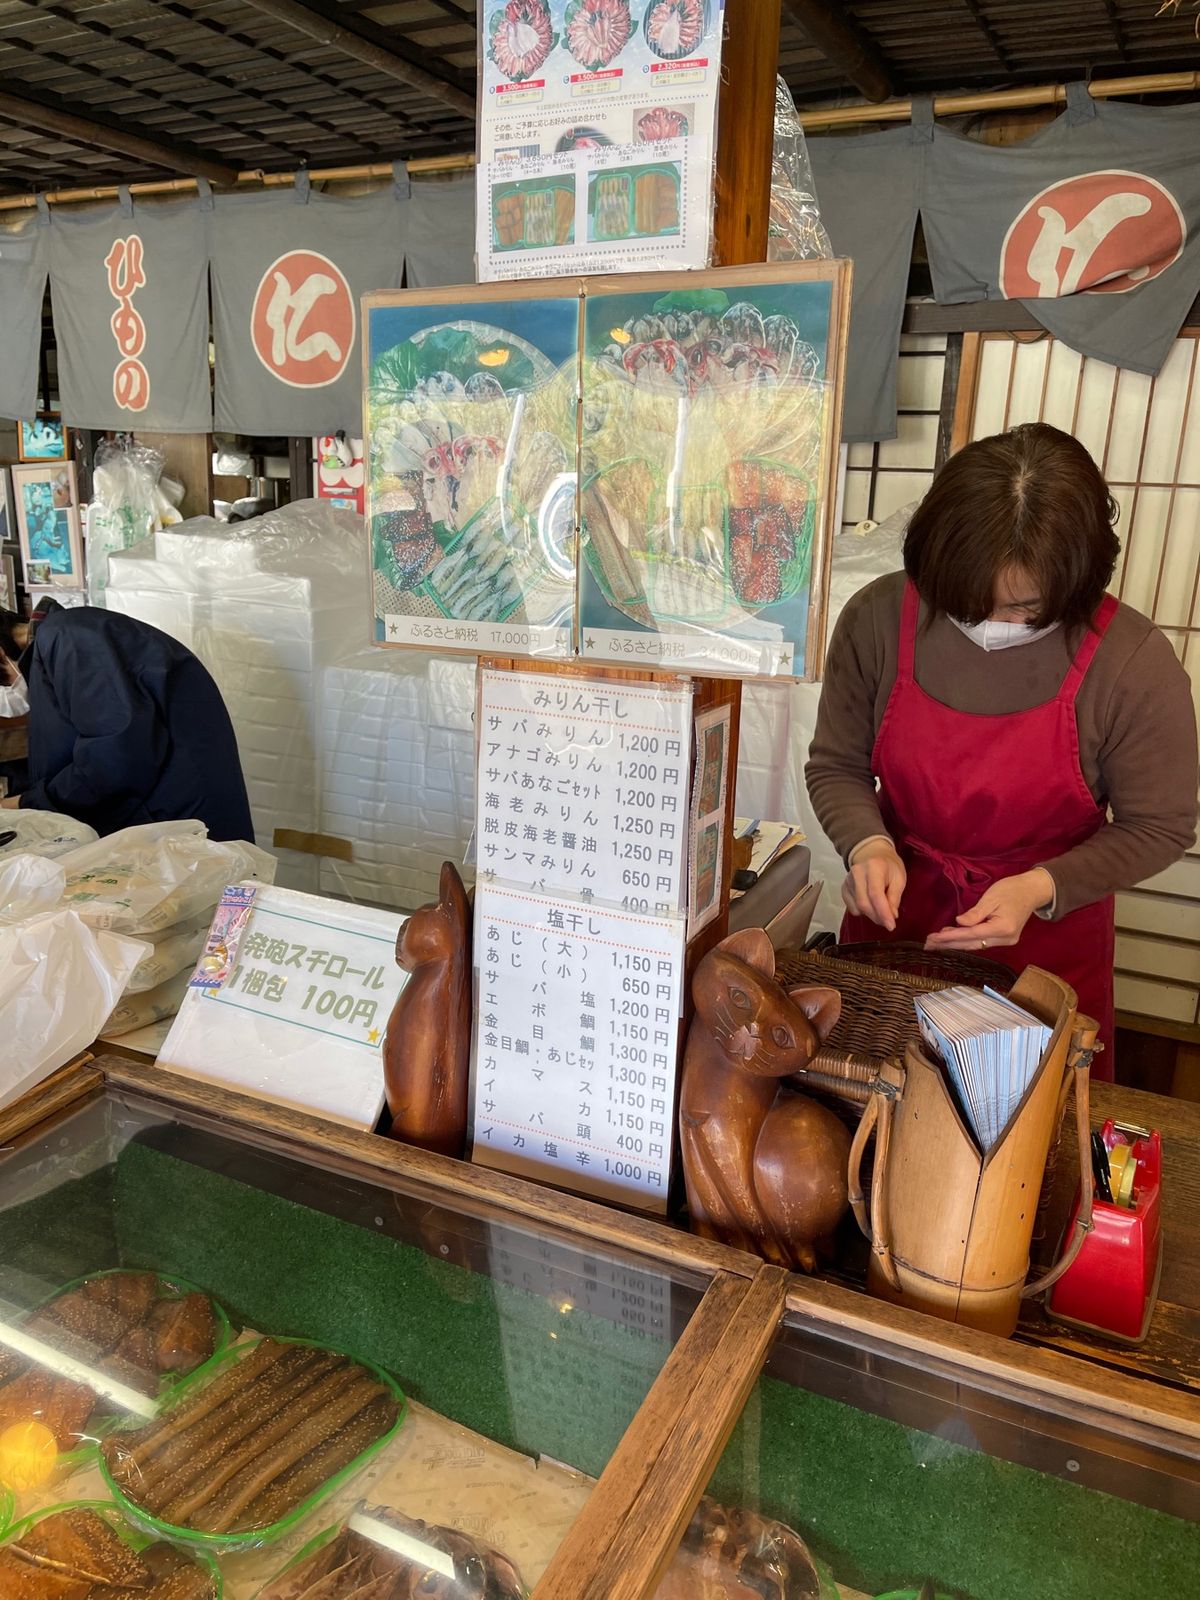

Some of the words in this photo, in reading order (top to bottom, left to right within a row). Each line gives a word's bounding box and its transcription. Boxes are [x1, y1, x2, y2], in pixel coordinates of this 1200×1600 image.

[410, 623, 479, 642] ふるさと納税
[608, 638, 686, 658] ふるさと納税
[533, 690, 629, 719] みりん干し
[488, 715, 604, 746] サバみりん
[486, 742, 602, 773] アナゴみりん
[485, 792, 599, 826] 海老みりん
[484, 818, 597, 853] 脱皮海老醤油
[484, 843, 596, 878] サンマみりん
[547, 909, 602, 936] 塩干し
[228, 965, 289, 1004] 1梱包
[301, 985, 379, 1028] 100円
[485, 969, 596, 1008] サバ塩
[485, 993, 595, 1030] エボ鯛
[484, 1012, 595, 1052] 金目鯛
[484, 1055, 593, 1096] カマス
[484, 1078, 592, 1118] イカ
[482, 1099, 592, 1141] サバ頭
[482, 1126, 591, 1167] イカ塩辛
